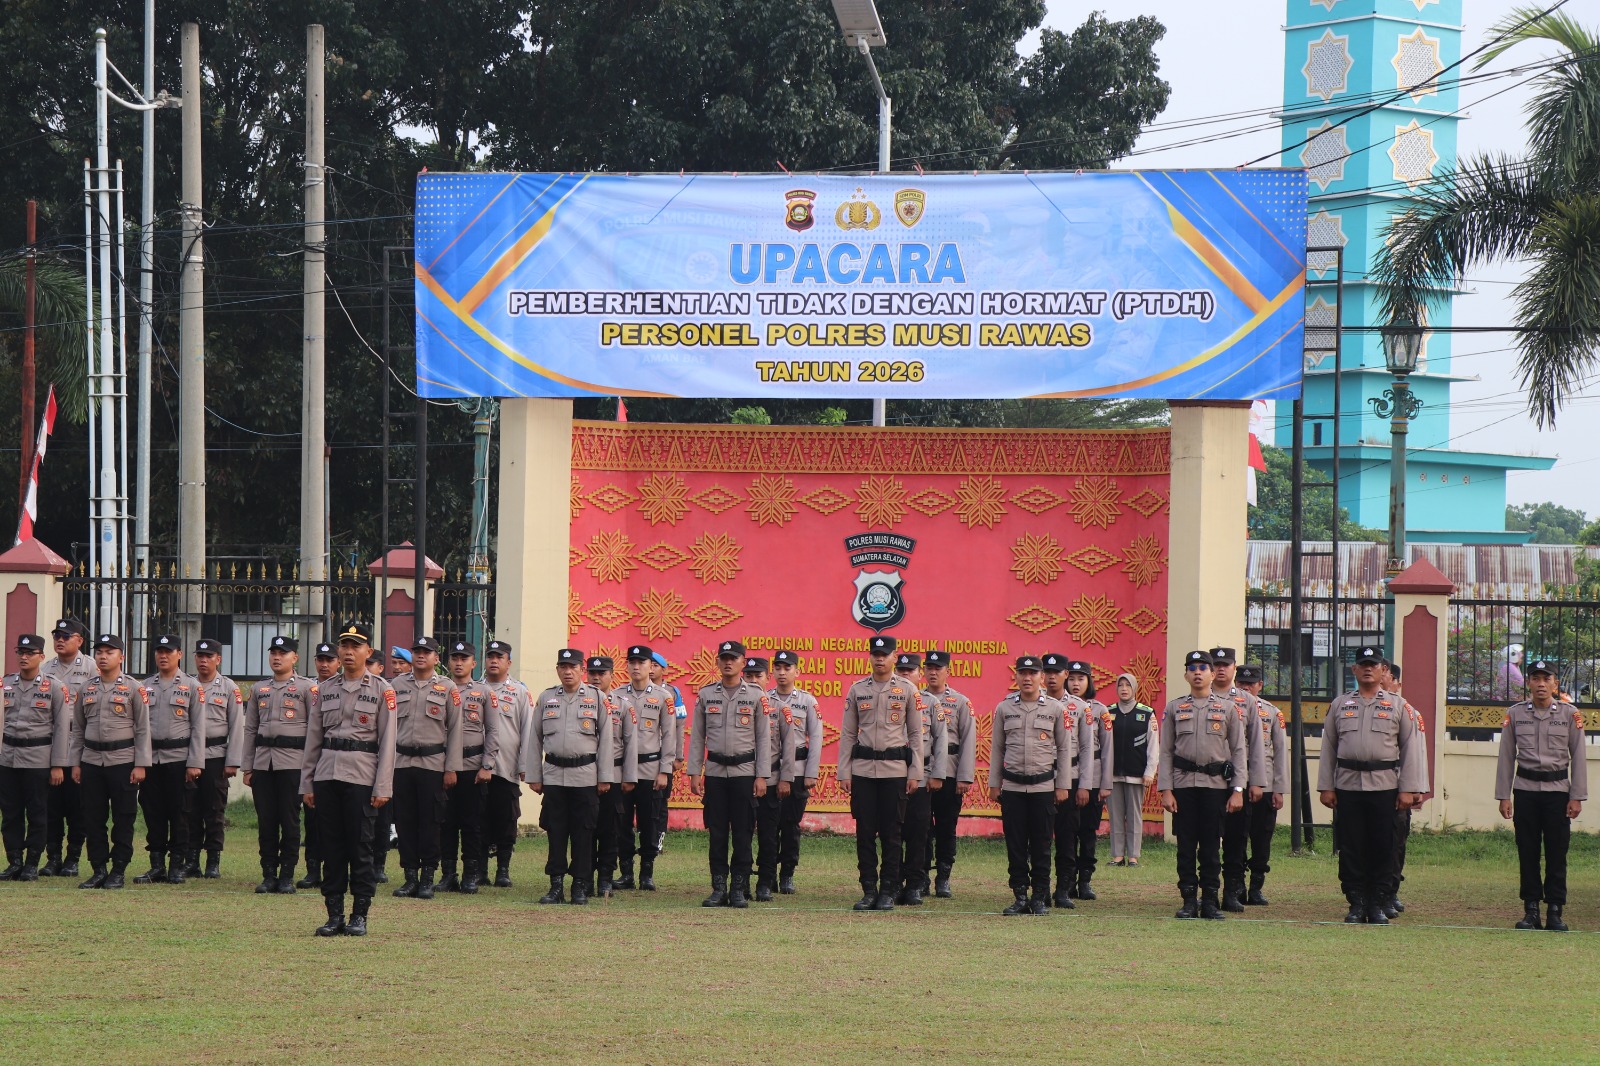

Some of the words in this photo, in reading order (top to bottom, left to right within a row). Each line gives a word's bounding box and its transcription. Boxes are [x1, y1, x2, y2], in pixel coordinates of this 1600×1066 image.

[664, 212, 699, 224] MUSI
[730, 242, 966, 285] UPACARA
[508, 293, 751, 315] PEMBERHENTIAN
[757, 293, 847, 315] TIDAK
[852, 293, 975, 315] DENGAN
[981, 293, 1107, 315] HORMAT
[1111, 292, 1215, 320] (PTDH)
[601, 323, 759, 346] PERSONEL
[766, 323, 886, 346] POLRES
[893, 323, 971, 346] MUSI
[979, 323, 1092, 346] RAWAS
[755, 361, 851, 382] TAHUN
[857, 361, 925, 382] 2026
[848, 536, 873, 548] POLRES
[874, 535, 888, 544] MUSI
[890, 537, 912, 549] RAWAS
[852, 554, 882, 564] SUMATERA
[882, 554, 907, 565] SELATAN
[742, 636, 813, 651] KEPOLISIAN
[821, 637, 870, 652] NEGARA
[896, 639, 939, 653] PUBLIK
[944, 639, 1008, 655] INDONESIA
[33, 692, 52, 700] POLRI
[173, 690, 190, 698] POLRI
[283, 692, 300, 700] POLRI
[358, 694, 378, 704] POLRI
[430, 690, 446, 698] POLRI
